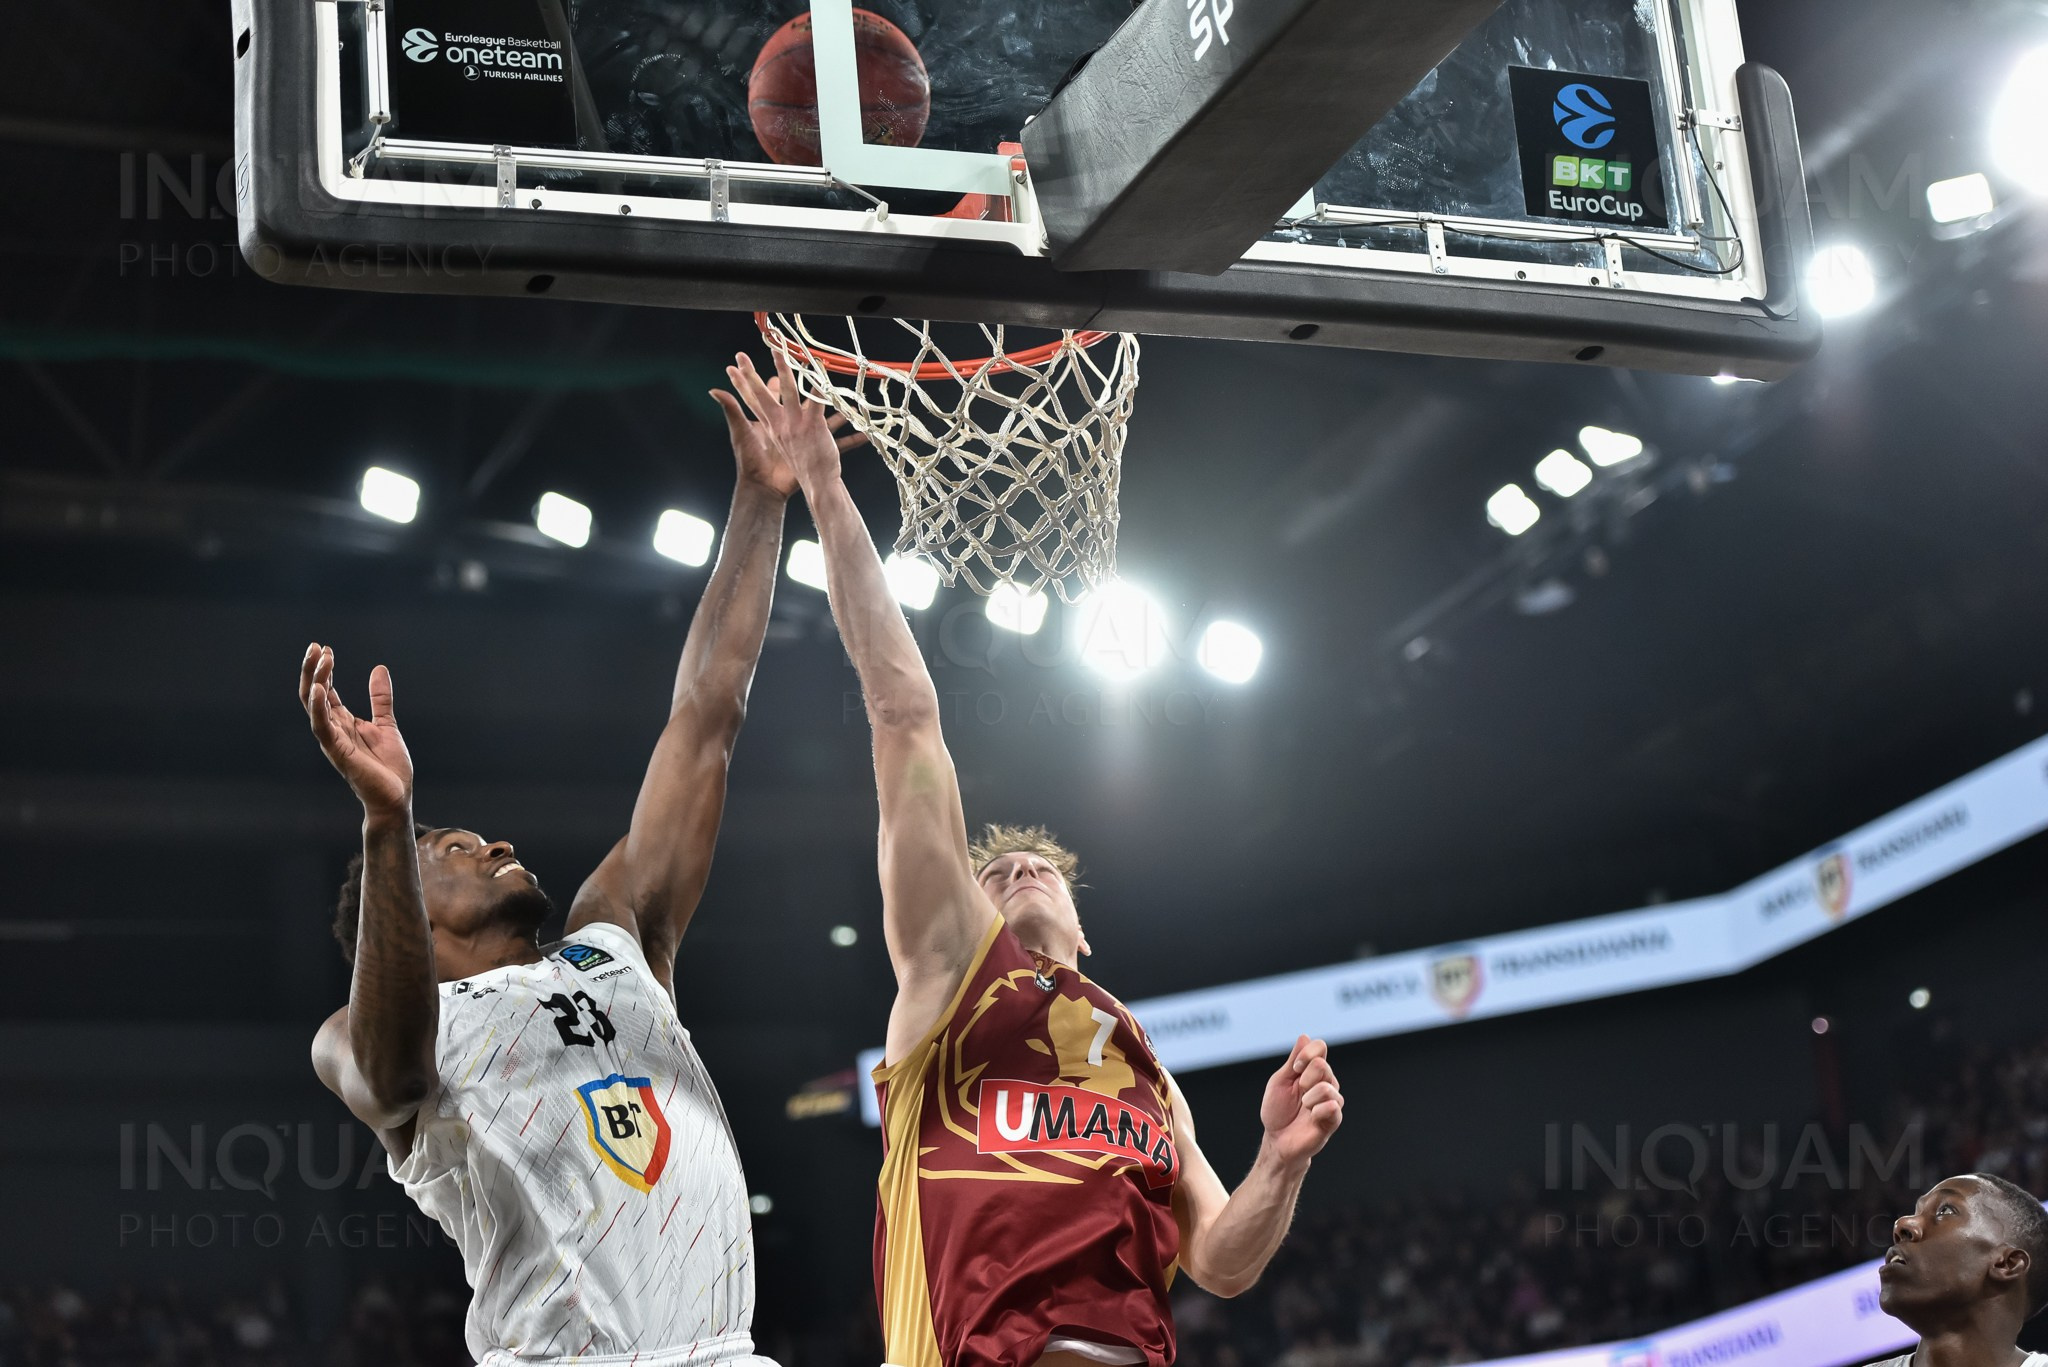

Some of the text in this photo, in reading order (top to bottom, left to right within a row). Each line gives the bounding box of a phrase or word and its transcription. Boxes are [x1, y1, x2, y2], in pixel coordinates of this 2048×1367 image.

[445, 32, 562, 50] Euroleague Basketball
[446, 46, 562, 70] oneteam
[483, 70, 564, 83] TURKISH AIRLINES
[1555, 160, 1629, 186] BKT
[1549, 190, 1644, 222] EuroCup
[537, 990, 617, 1048] 23
[1088, 1006, 1118, 1067] 7
[995, 1089, 1174, 1178] UMANA
